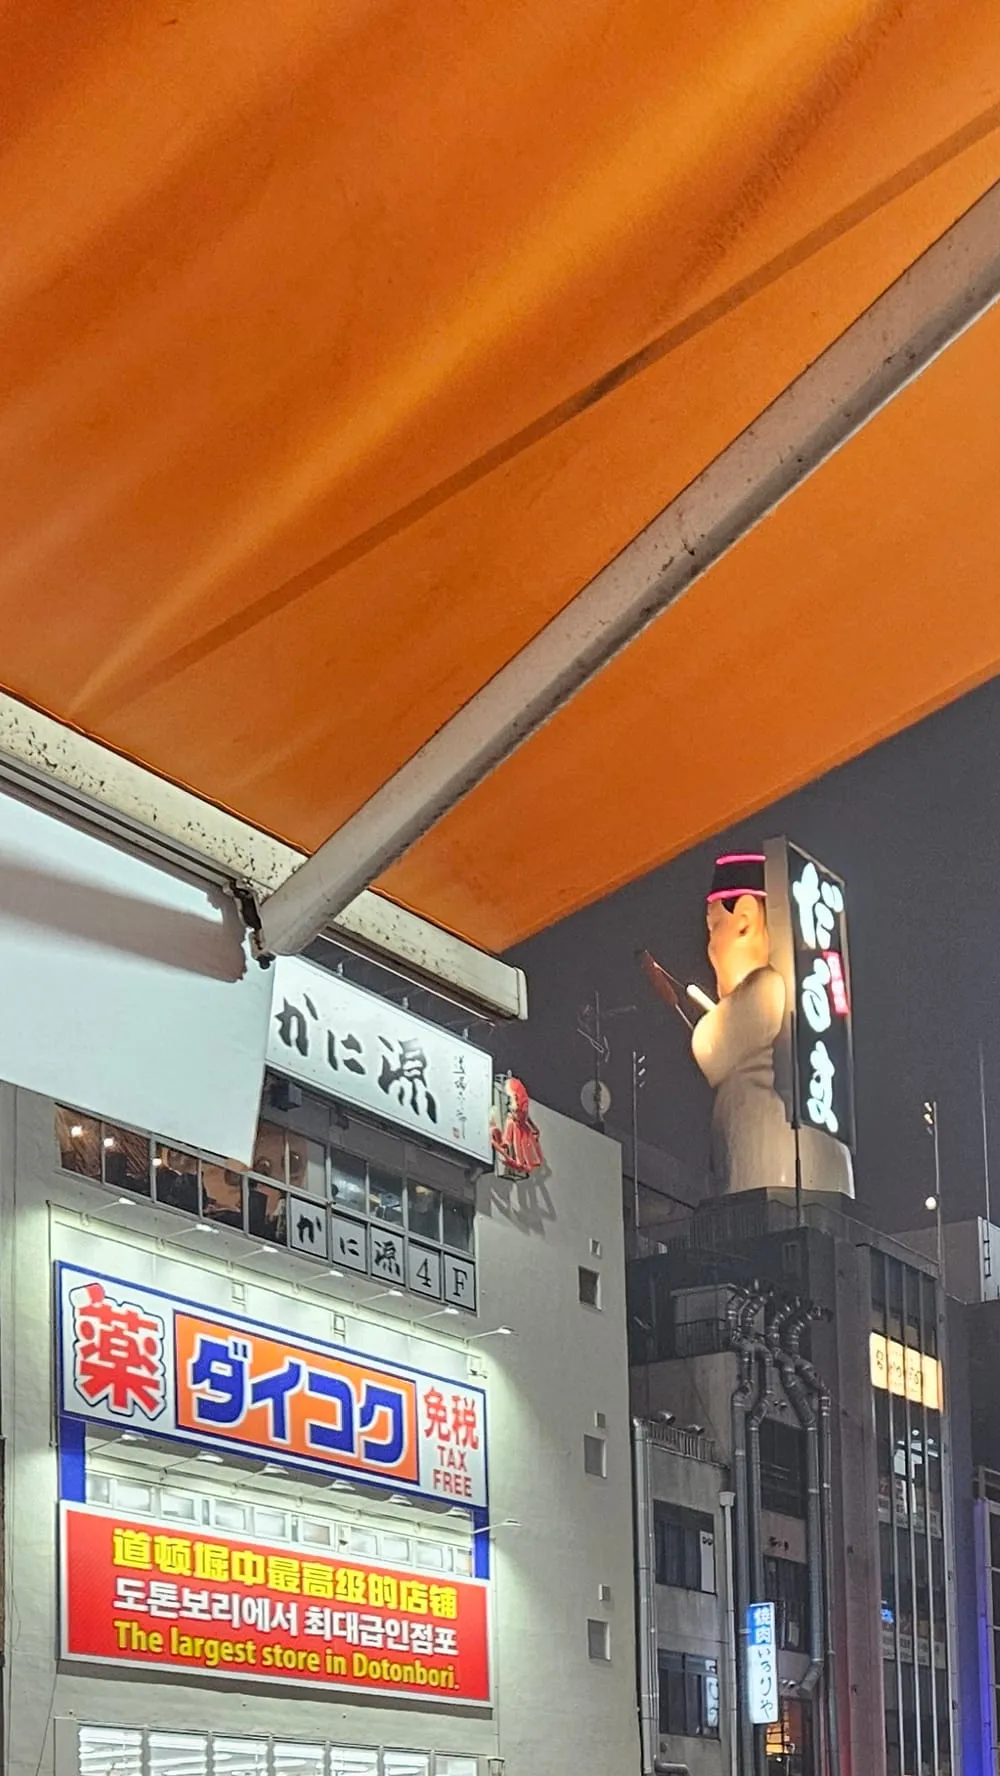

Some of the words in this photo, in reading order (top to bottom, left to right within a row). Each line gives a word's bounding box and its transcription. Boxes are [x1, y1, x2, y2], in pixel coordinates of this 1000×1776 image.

[274, 993, 438, 1124] かに源
[70, 1283, 160, 1415] 薬
[192, 1338, 403, 1464] ダイコク
[423, 1386, 479, 1451] 免税
[433, 1469, 472, 1498] FREE
[436, 1445, 468, 1472] TAX
[113, 1577, 298, 1636] 도톤보리에서
[303, 1605, 459, 1656] 최대급인점포
[114, 1621, 163, 1653] The
[170, 1626, 257, 1667] largest
[262, 1644, 321, 1672] store
[325, 1649, 348, 1675] in
[352, 1652, 460, 1690] Dotonbori.
